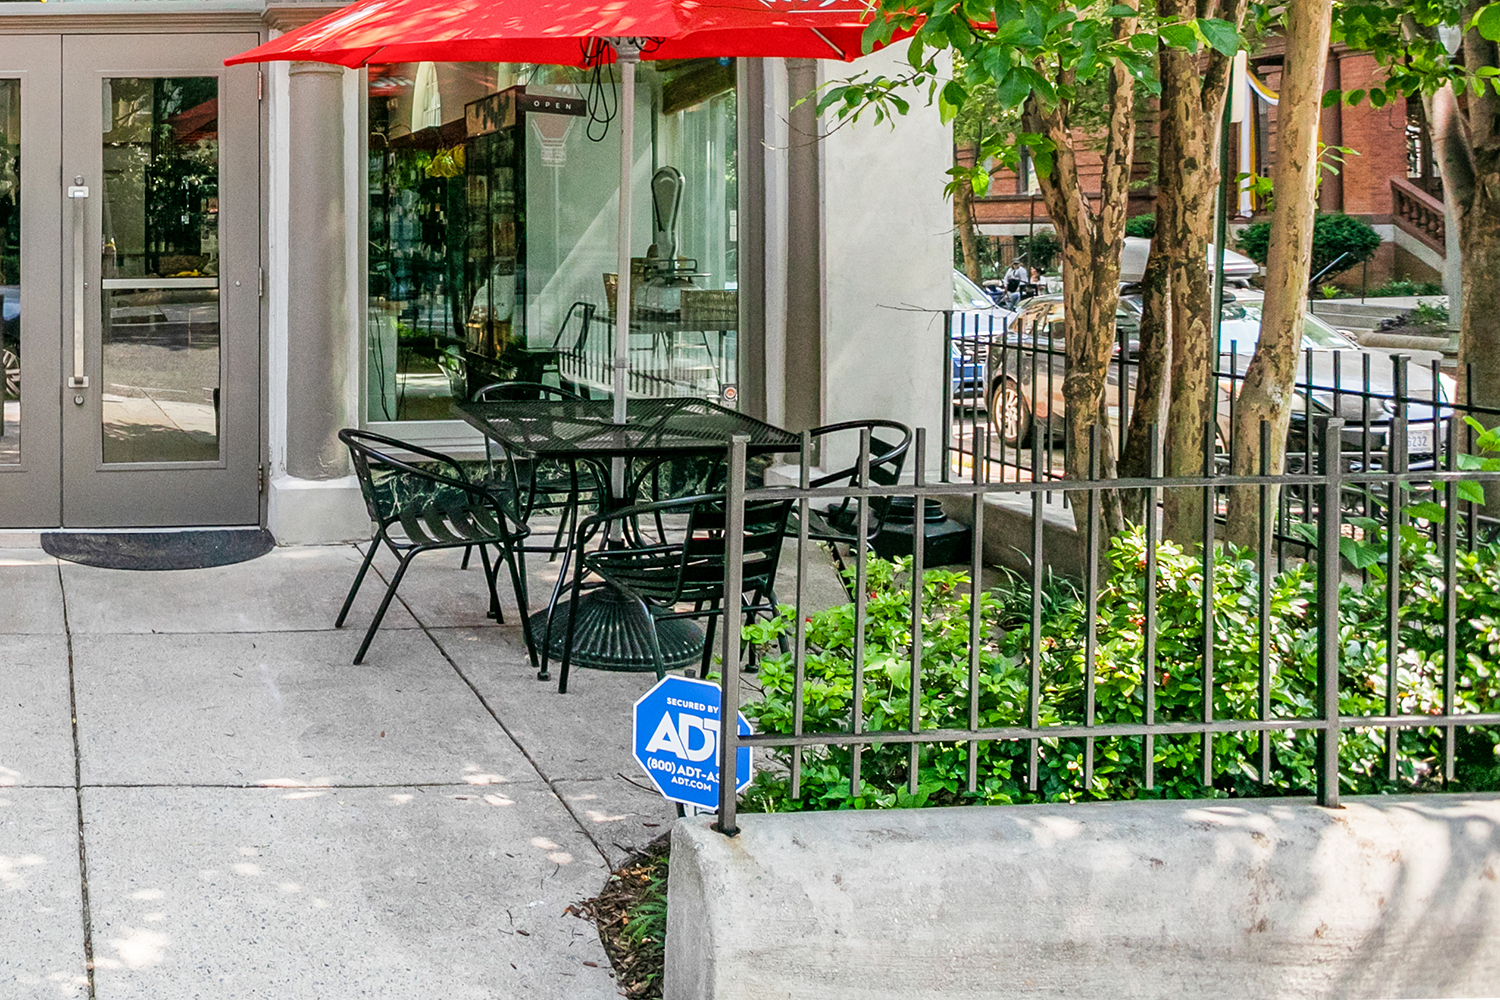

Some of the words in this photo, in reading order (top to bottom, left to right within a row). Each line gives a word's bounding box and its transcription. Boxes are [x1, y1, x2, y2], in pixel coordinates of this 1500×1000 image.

[533, 101, 571, 111] OPEN
[666, 697, 706, 711] SECURED
[707, 705, 719, 714] BY
[647, 756, 676, 775] (800)
[671, 776, 712, 792] ADT.COM
